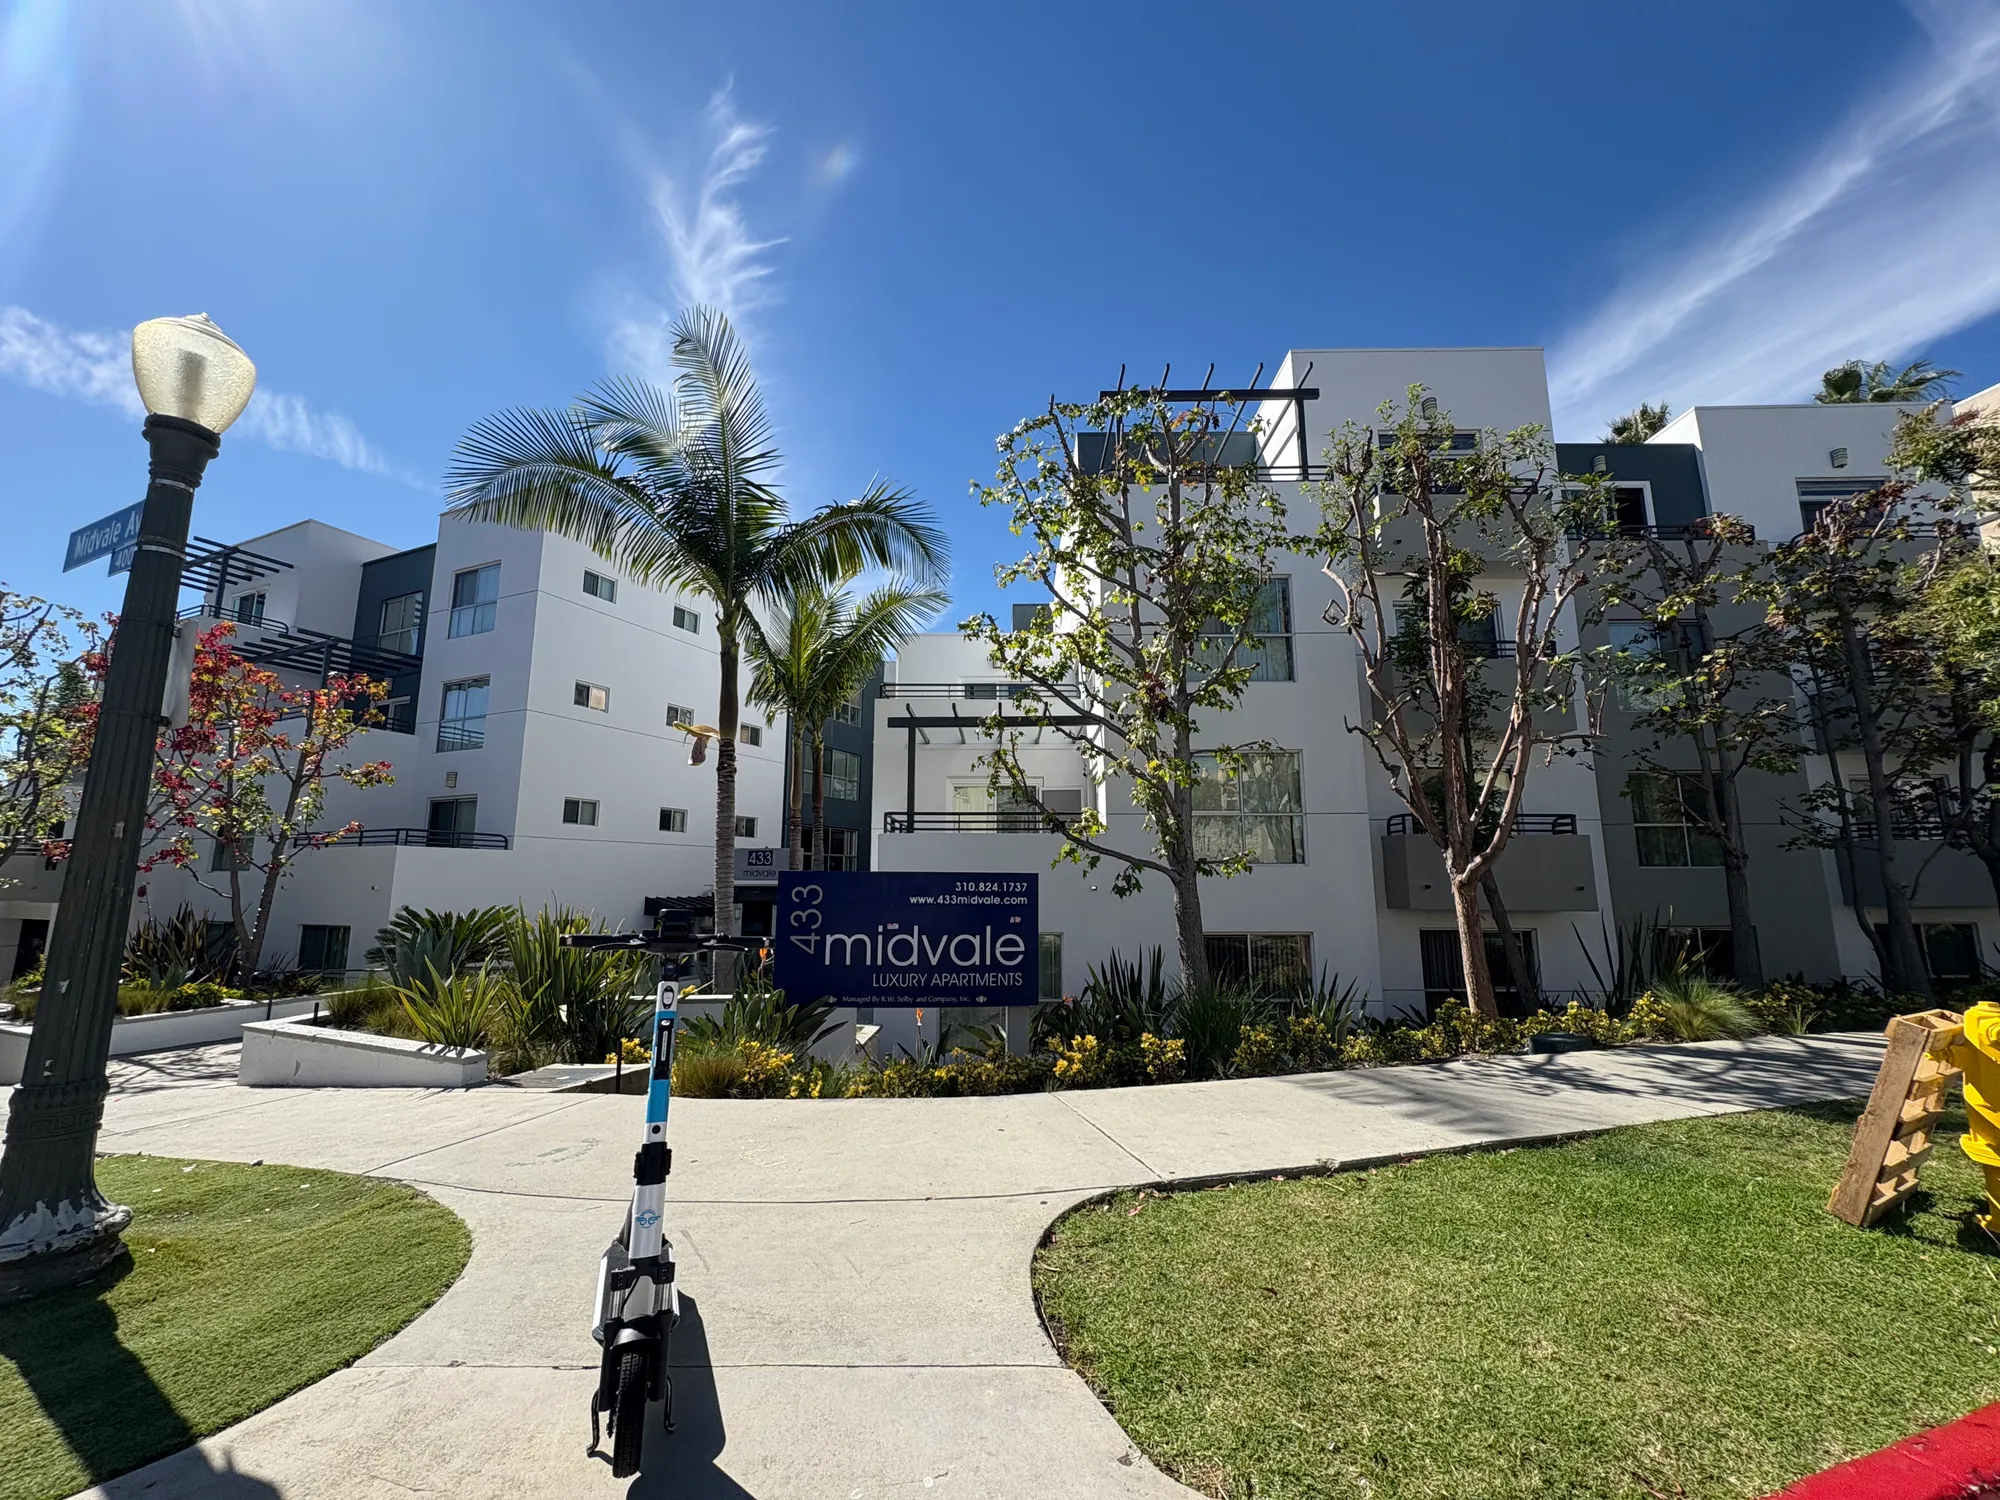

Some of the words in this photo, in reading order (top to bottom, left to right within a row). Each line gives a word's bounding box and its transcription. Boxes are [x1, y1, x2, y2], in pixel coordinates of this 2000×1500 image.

[74, 520, 121, 559] Midvale
[748, 851, 772, 865] 433
[743, 868, 776, 877] midvale
[955, 881, 1028, 892] 310.824.1737
[909, 894, 1028, 905] www.433midvale.com
[789, 884, 823, 955] 433
[824, 925, 1025, 966] midvale
[873, 972, 928, 987] LUXURY
[930, 972, 1023, 987] APARTMENTS
[842, 995, 871, 1004] Managed
[872, 995, 880, 1003] By
[915, 995, 927, 1003] and
